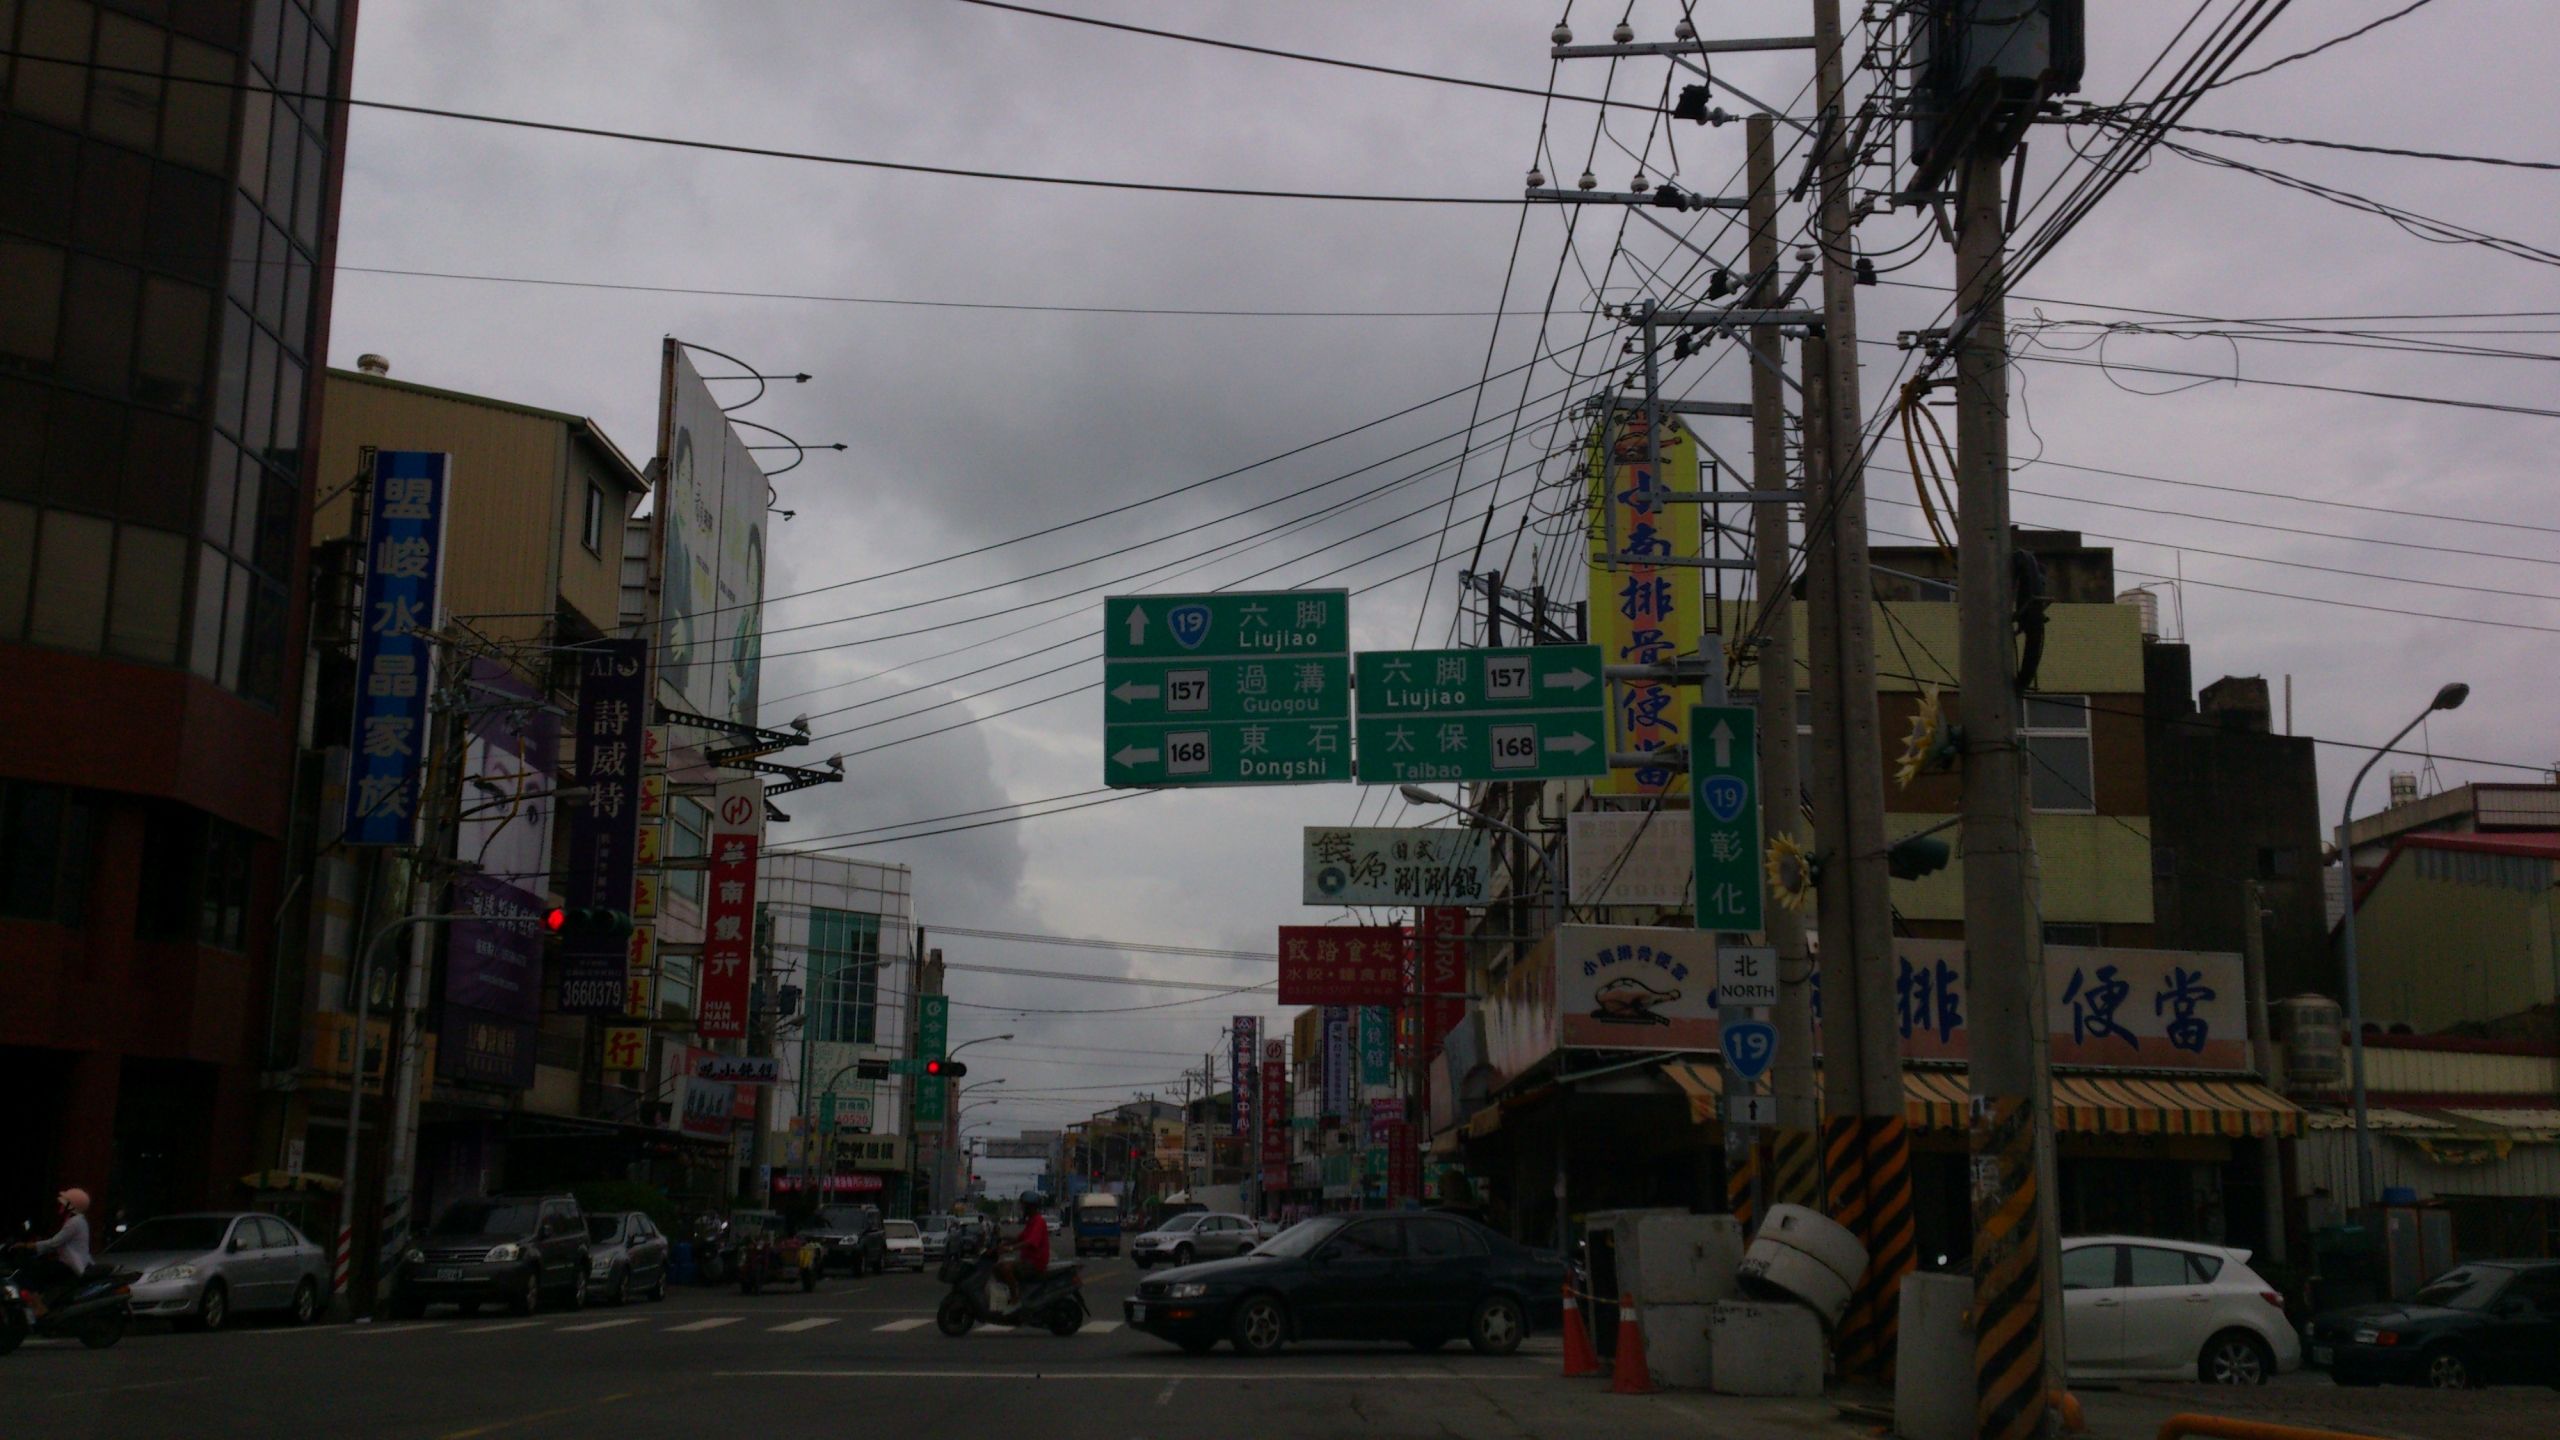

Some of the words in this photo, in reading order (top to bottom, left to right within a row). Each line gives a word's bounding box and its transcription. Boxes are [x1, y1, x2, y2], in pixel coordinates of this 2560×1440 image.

[1178, 612, 1204, 633] 19
[354, 478, 433, 819] 盟峻水晶家族
[1240, 631, 1318, 652] Liujiao
[1237, 663, 1326, 694] 過溝
[1491, 668, 1526, 687] 157
[1171, 681, 1205, 700] 157
[1386, 689, 1466, 710] Liujiao
[1243, 697, 1320, 715] Guogou
[1239, 724, 1339, 755] 東石
[1385, 723, 1468, 753] 太保
[1497, 737, 1533, 757] 168
[1171, 742, 1205, 762] 168
[1240, 758, 1326, 779] Dongshi
[1392, 762, 1462, 780] Taibao
[1713, 787, 1737, 808] 19
[1394, 866, 1482, 899] 涮涮鍋
[1710, 829, 1746, 915] 彰化
[711, 841, 748, 979] 華南銀行
[1734, 955, 1758, 977] 北
[563, 980, 622, 1006] 3660379
[1721, 985, 1775, 998] NORTH
[705, 1002, 732, 1010] HUA
[705, 1011, 732, 1020] NAN
[704, 1021, 740, 1031] BANK
[1732, 1033, 1768, 1059] 19
